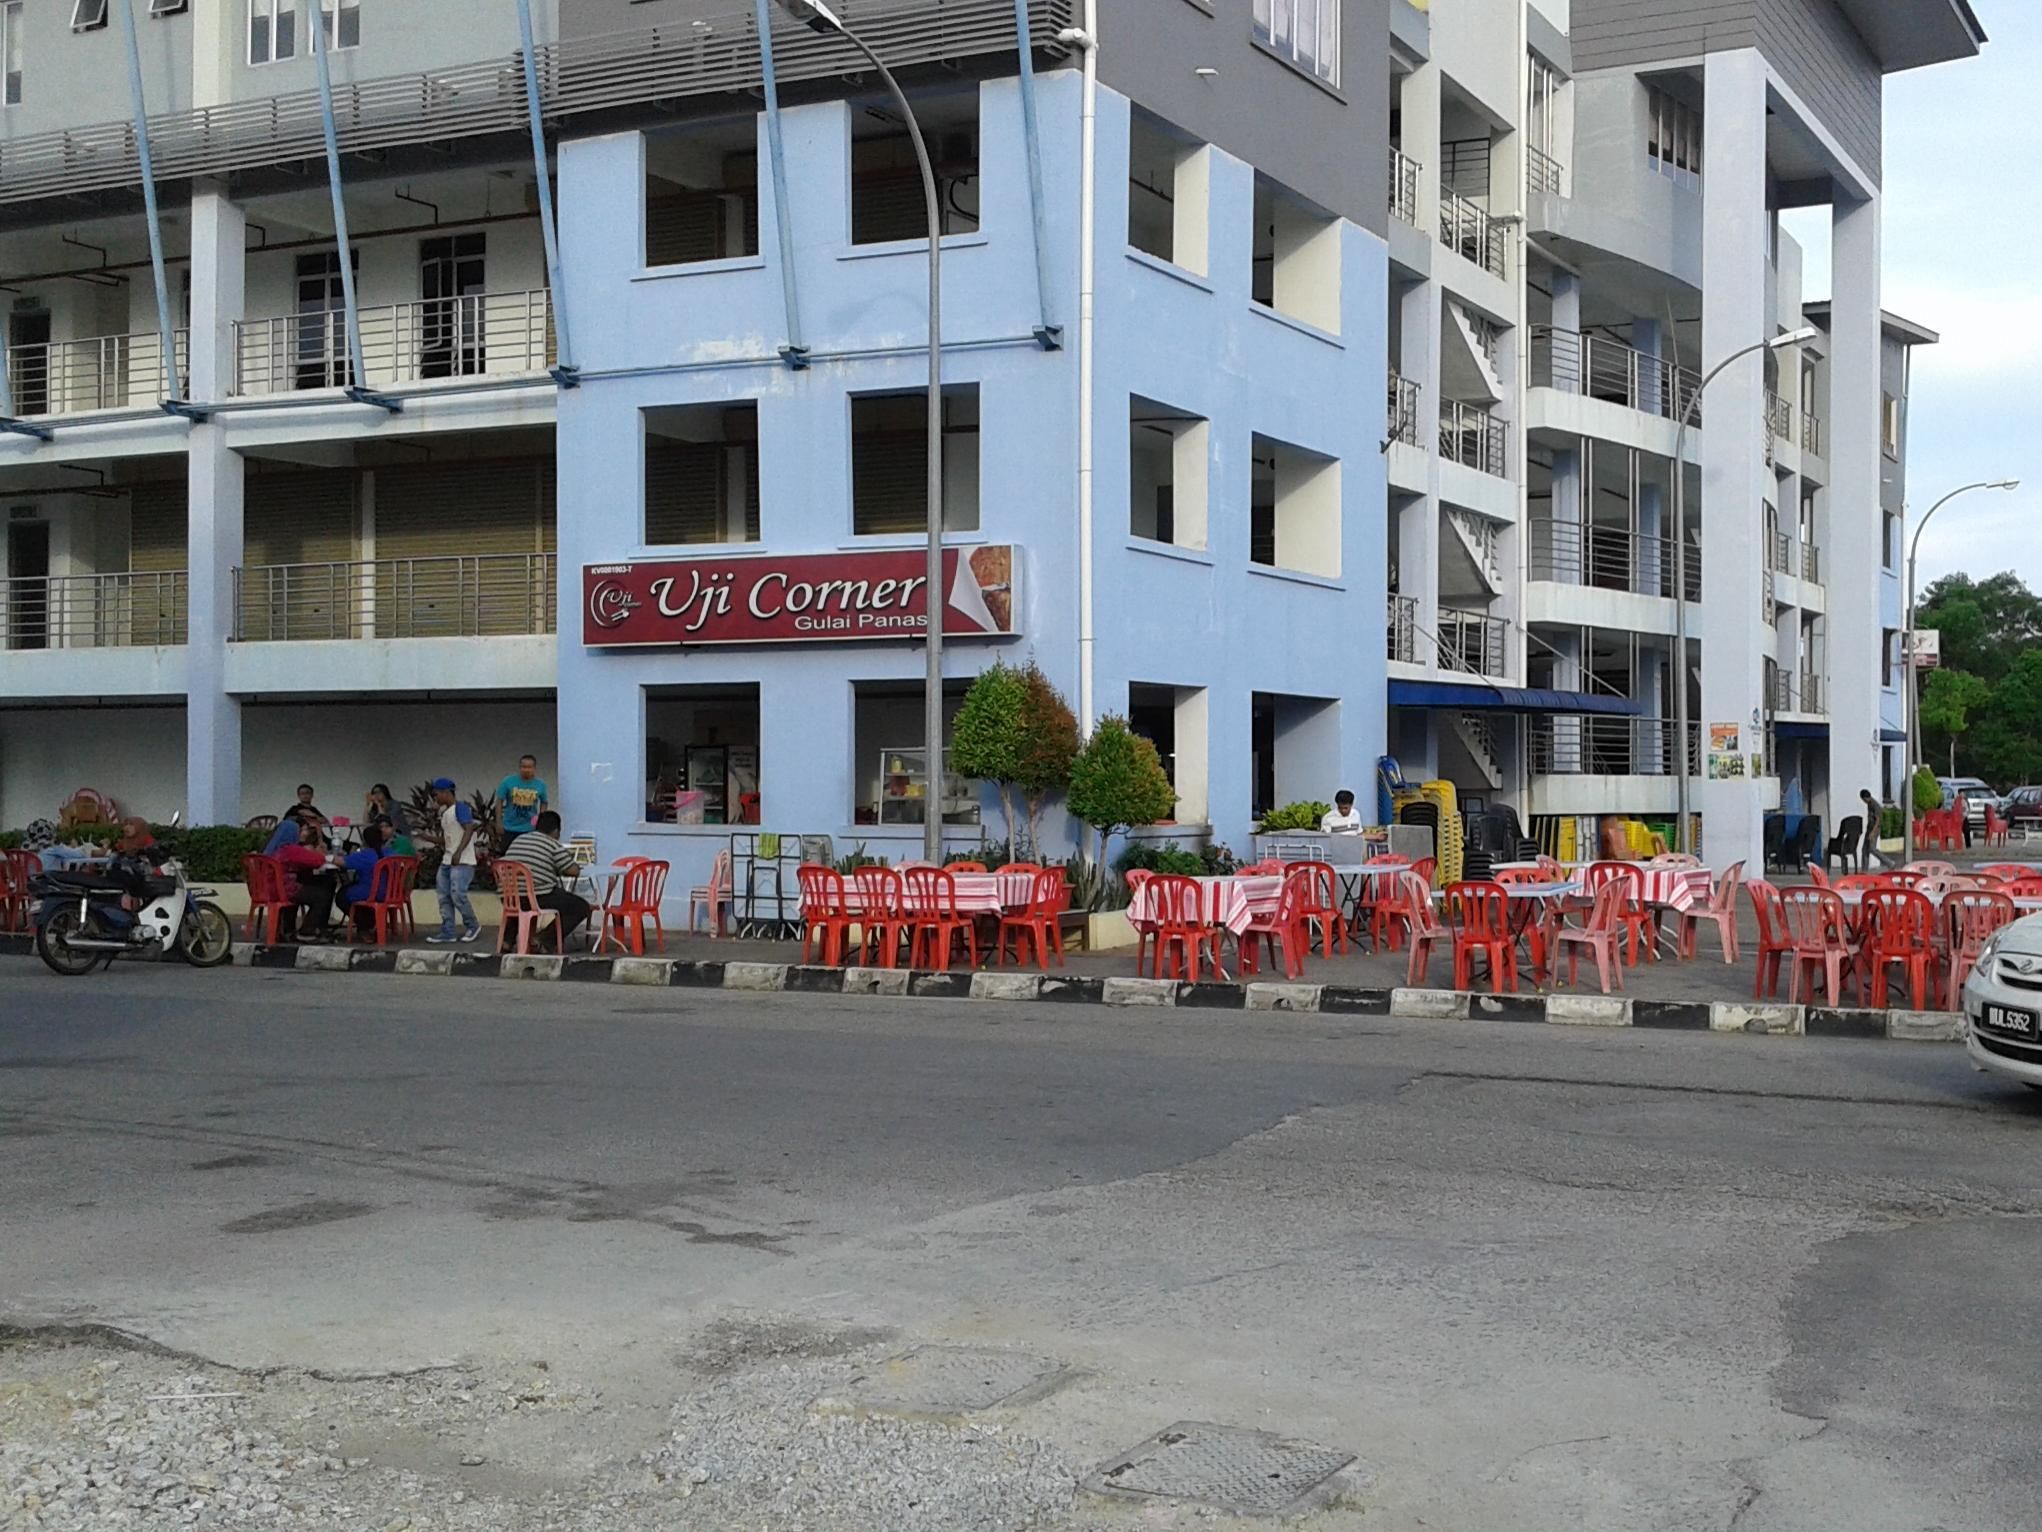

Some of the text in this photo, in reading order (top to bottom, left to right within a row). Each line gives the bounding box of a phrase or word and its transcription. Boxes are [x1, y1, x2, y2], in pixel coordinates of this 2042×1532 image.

[650, 569, 927, 631] Uji Corner
[794, 613, 928, 630] Gulai Panas
